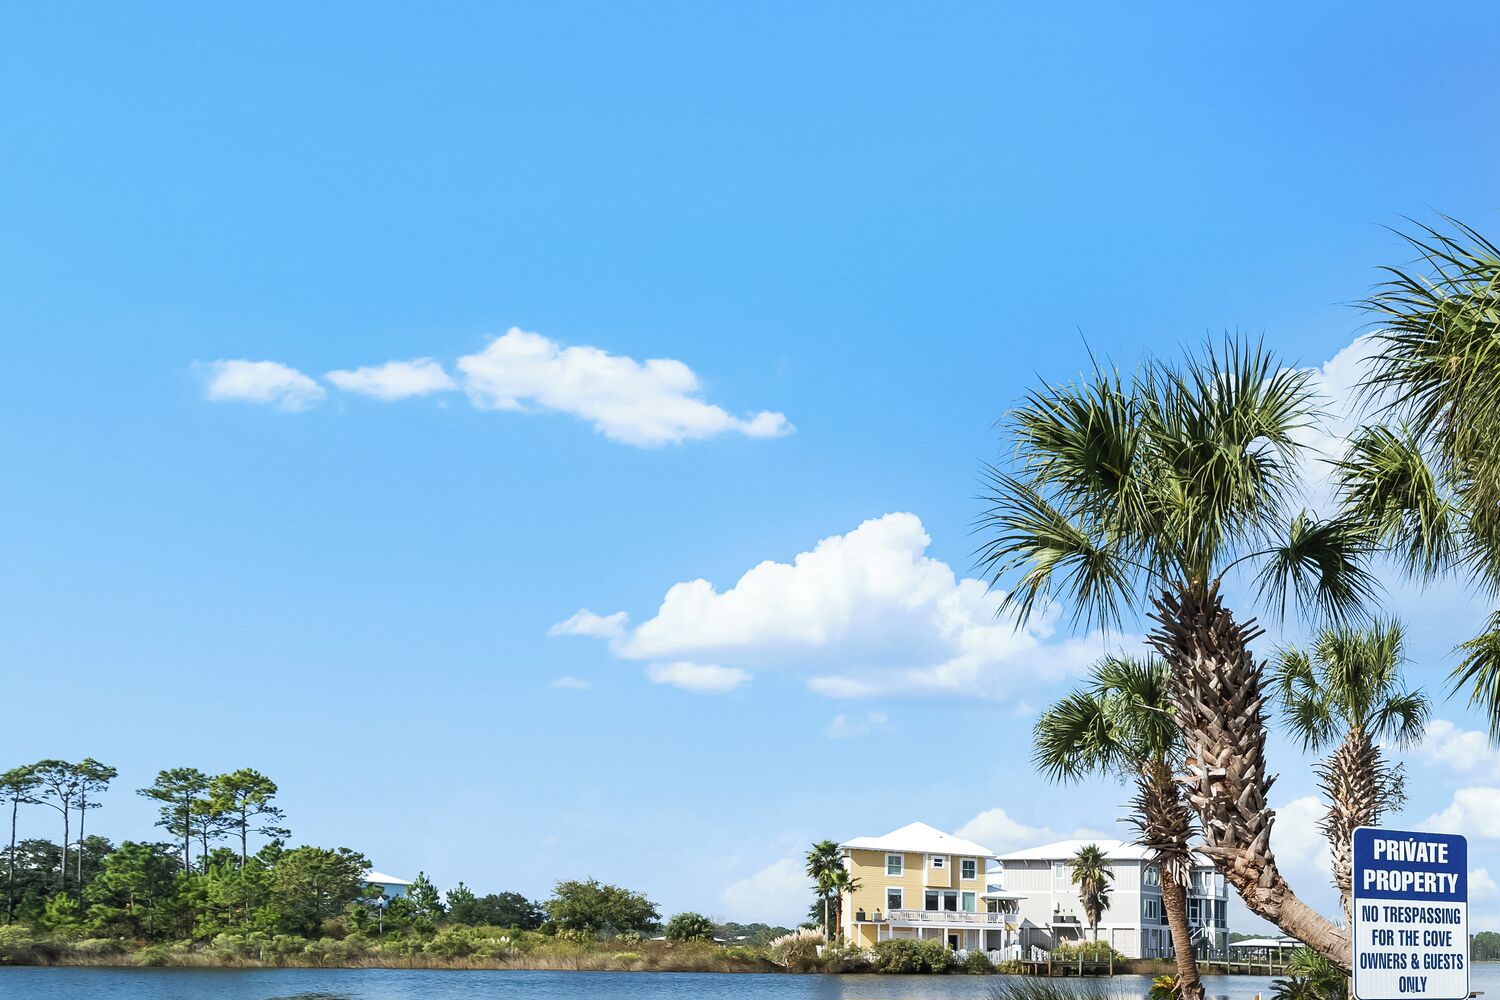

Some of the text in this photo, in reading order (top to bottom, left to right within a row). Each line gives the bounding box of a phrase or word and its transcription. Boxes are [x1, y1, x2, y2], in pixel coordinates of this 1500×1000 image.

[1373, 839, 1449, 864] PRIVATE
[1363, 869, 1459, 894] PROPERTY
[1362, 905, 1461, 925] NO TRESPASSING
[1372, 929, 1452, 947] FOR THE COVE
[1360, 952, 1464, 970] OWNERS & GUESTS
[1399, 975, 1427, 993] ONLY
